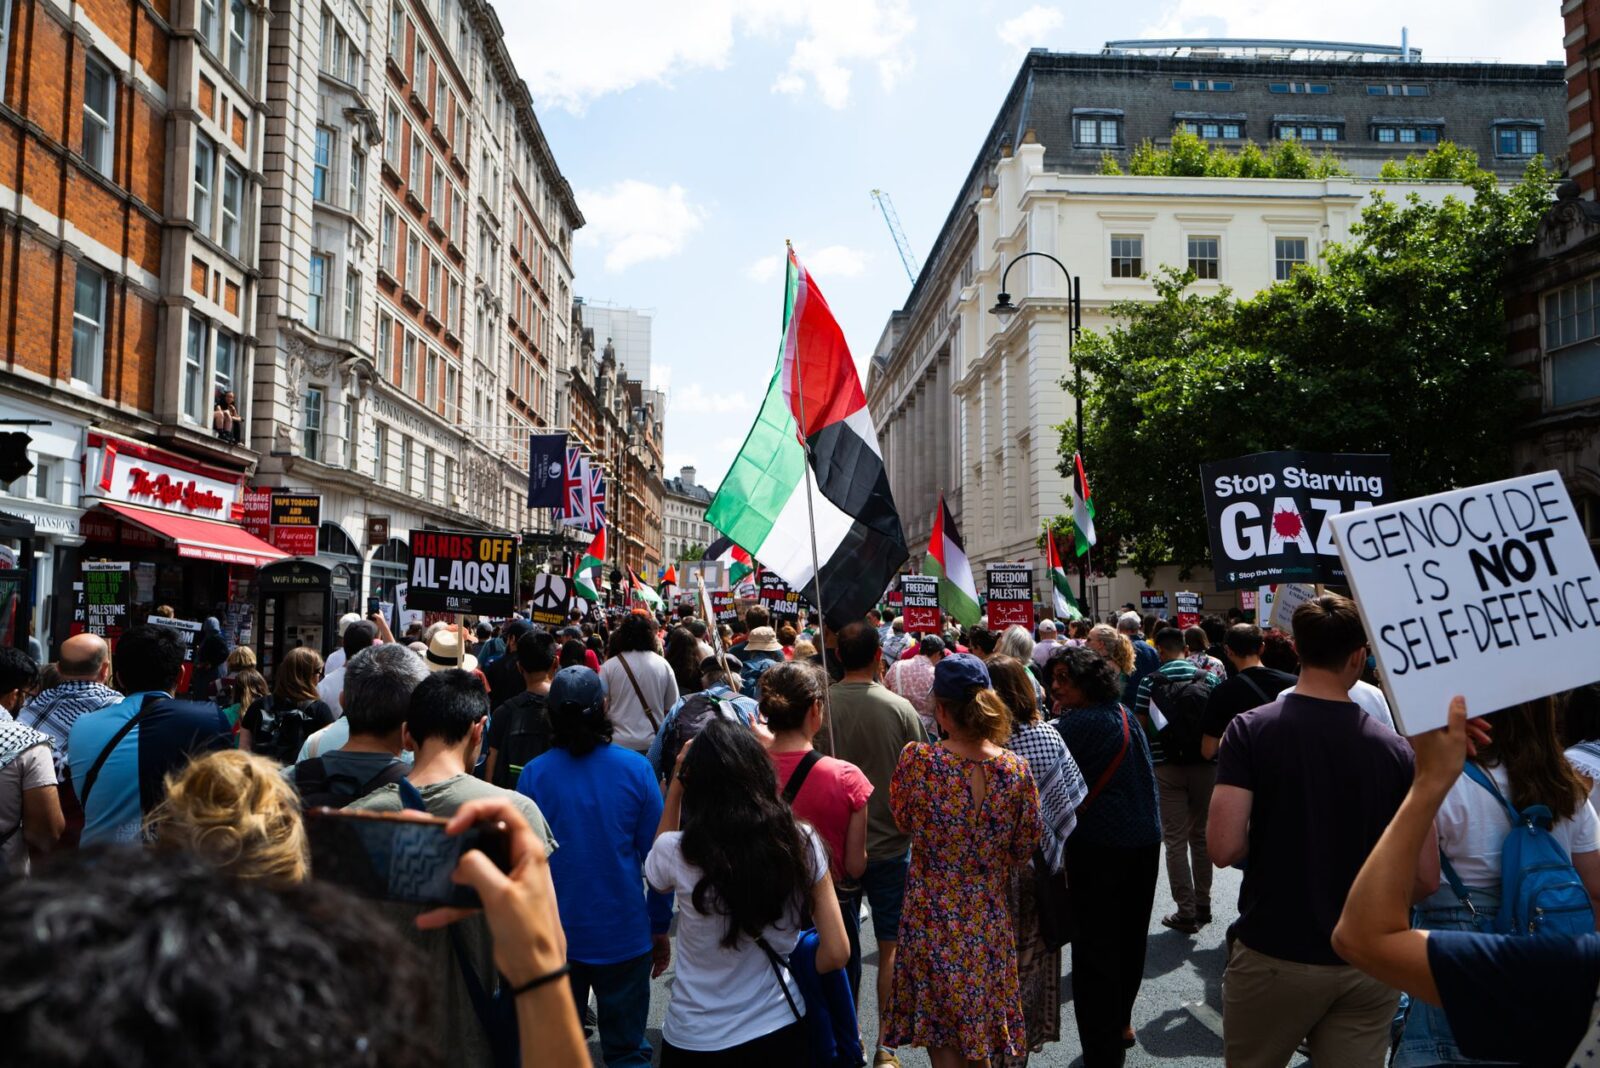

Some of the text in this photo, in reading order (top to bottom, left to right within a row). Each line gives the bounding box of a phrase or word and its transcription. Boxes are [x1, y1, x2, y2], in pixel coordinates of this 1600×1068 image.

[373, 395, 457, 454] BONNINGTON HOTEL
[1214, 466, 1384, 498] Stop Starving
[128, 467, 223, 511] The Red London
[244, 493, 269, 502] UGGAGE
[291, 498, 318, 507] TOBACCO
[244, 502, 269, 511] OLDING
[33, 515, 75, 531] MANSIONS
[1347, 481, 1568, 562] GENOCIDE
[1220, 497, 1375, 561] GAZ
[413, 532, 513, 563] HANDS OFF
[1404, 527, 1558, 604] IS NOT
[87, 571, 123, 582] FROM THE
[272, 575, 310, 584] WiFi here
[411, 556, 511, 595] AL-AQSA
[762, 576, 780, 584] Stop
[991, 571, 1028, 583] FREEDOM
[1238, 571, 1256, 580] Stop
[109, 583, 119, 594] TO
[905, 583, 936, 593] FREEDOM
[88, 593, 100, 604] THE
[786, 592, 800, 602] OFF
[989, 588, 1031, 600] PALESTINE
[446, 596, 459, 607] FOA
[904, 596, 938, 607] PALESTINE
[88, 604, 126, 615] PALESTINE
[996, 603, 1024, 615] الحرية
[88, 615, 105, 626] WILL
[106, 615, 116, 626] BE
[1380, 576, 1600, 675] SELF-DEFENCE
[88, 625, 106, 636] FREE
